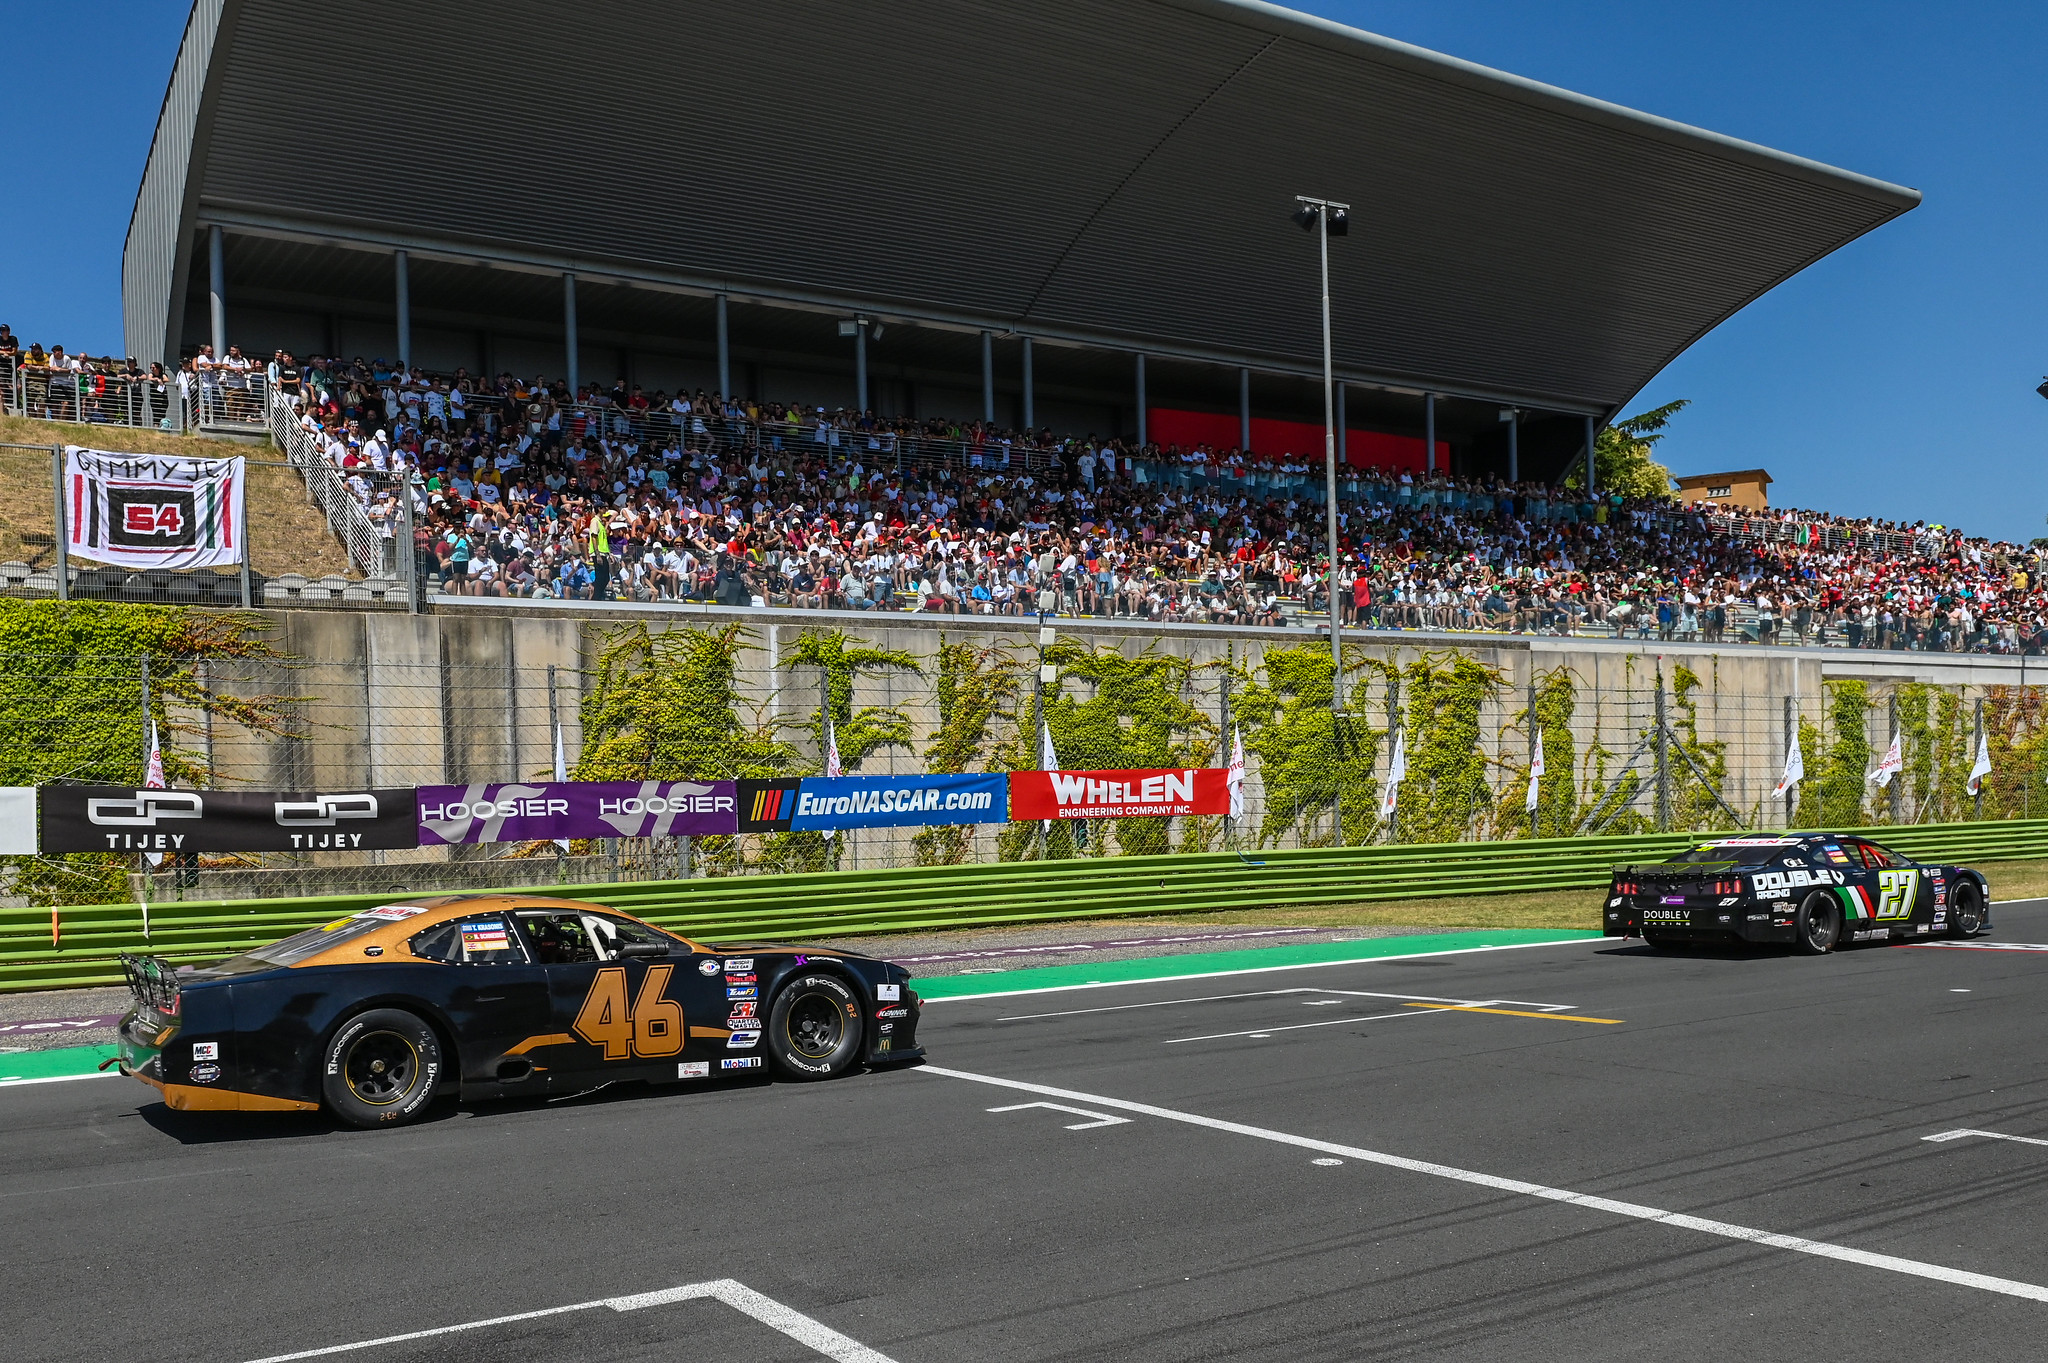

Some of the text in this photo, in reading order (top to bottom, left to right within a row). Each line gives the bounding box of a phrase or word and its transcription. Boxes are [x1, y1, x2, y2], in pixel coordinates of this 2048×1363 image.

[76, 450, 178, 479] GIMMY
[127, 506, 181, 531] 54
[1048, 770, 1194, 805] WHELEN
[420, 799, 569, 821] HOOSIER
[599, 796, 734, 815] HOOSIER
[797, 788, 992, 816] EuroNASCAR.com
[1058, 805, 1193, 818] ENGINEERING COMPANY INC.
[106, 834, 186, 850] TIJEY
[290, 833, 362, 849] TIJEY
[1752, 869, 1845, 891] DOUBLE V
[1718, 897, 1739, 906] 27
[1756, 888, 1790, 900] RACING
[1876, 869, 1919, 921] 27
[1643, 910, 1690, 919] DOUBLE V
[725, 974, 757, 983] WHELEN
[815, 979, 849, 999] HOOSIER
[572, 964, 685, 1062] 46
[728, 1018, 759, 1027] QUARTER
[195, 1045, 211, 1055] MCC
[331, 1022, 364, 1063] HOOSIER
[724, 1058, 759, 1068] Mobil 1
[786, 1052, 822, 1072] HOOSIER
[403, 1073, 435, 1114] HOOSIER
